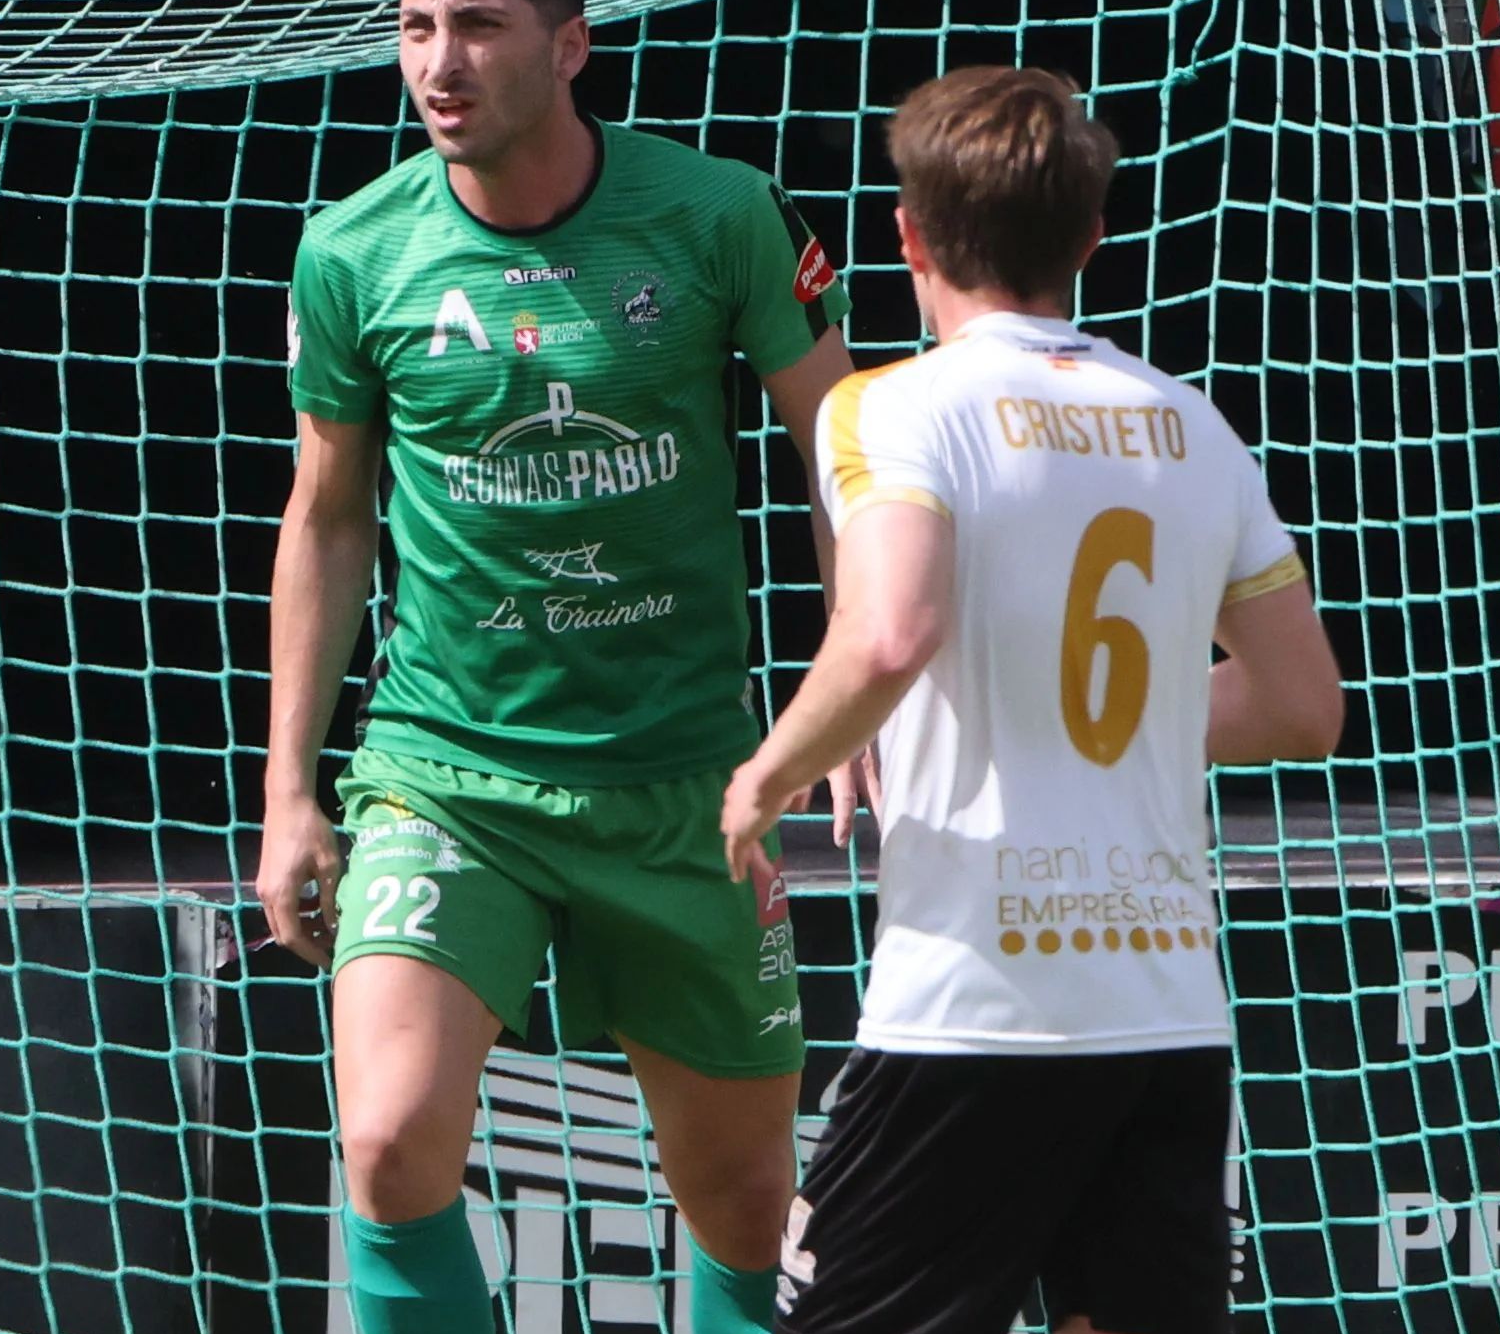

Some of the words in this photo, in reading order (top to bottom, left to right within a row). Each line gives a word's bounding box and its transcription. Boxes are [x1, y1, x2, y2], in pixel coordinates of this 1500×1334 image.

[996, 397, 1186, 460] CRISTETO
[444, 452, 561, 504] CECINAS
[565, 432, 681, 499] PABLO
[476, 596, 526, 630] La
[543, 593, 678, 633] Trainera
[1060, 508, 1153, 767] 6
[362, 875, 441, 941] 22
